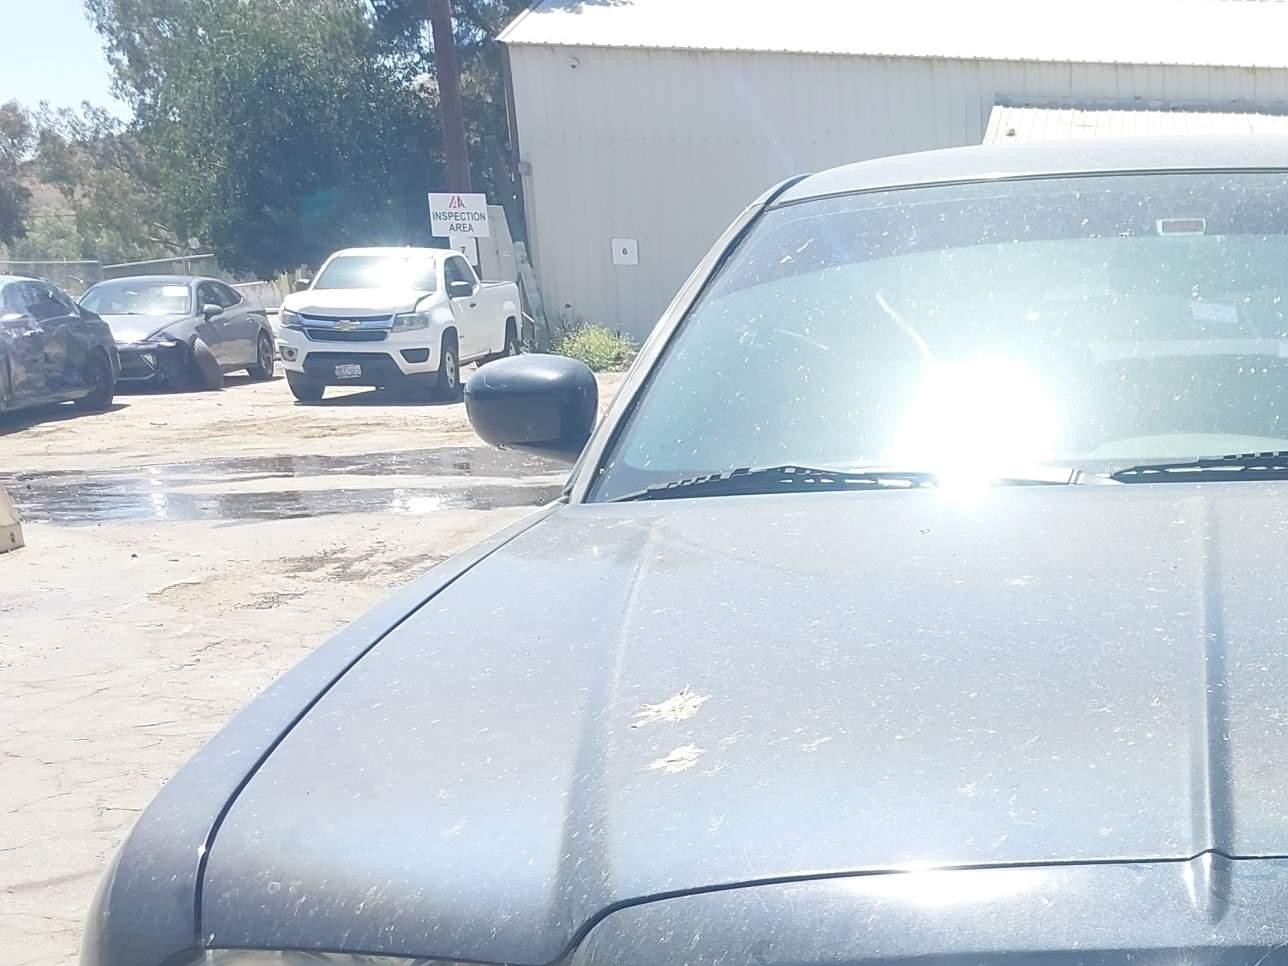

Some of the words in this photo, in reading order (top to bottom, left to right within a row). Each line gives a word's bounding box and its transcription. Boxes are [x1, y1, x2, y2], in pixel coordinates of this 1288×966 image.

[432, 211, 487, 222] INSPECTION
[449, 223, 474, 233] AREA
[622, 247, 628, 256] 6
